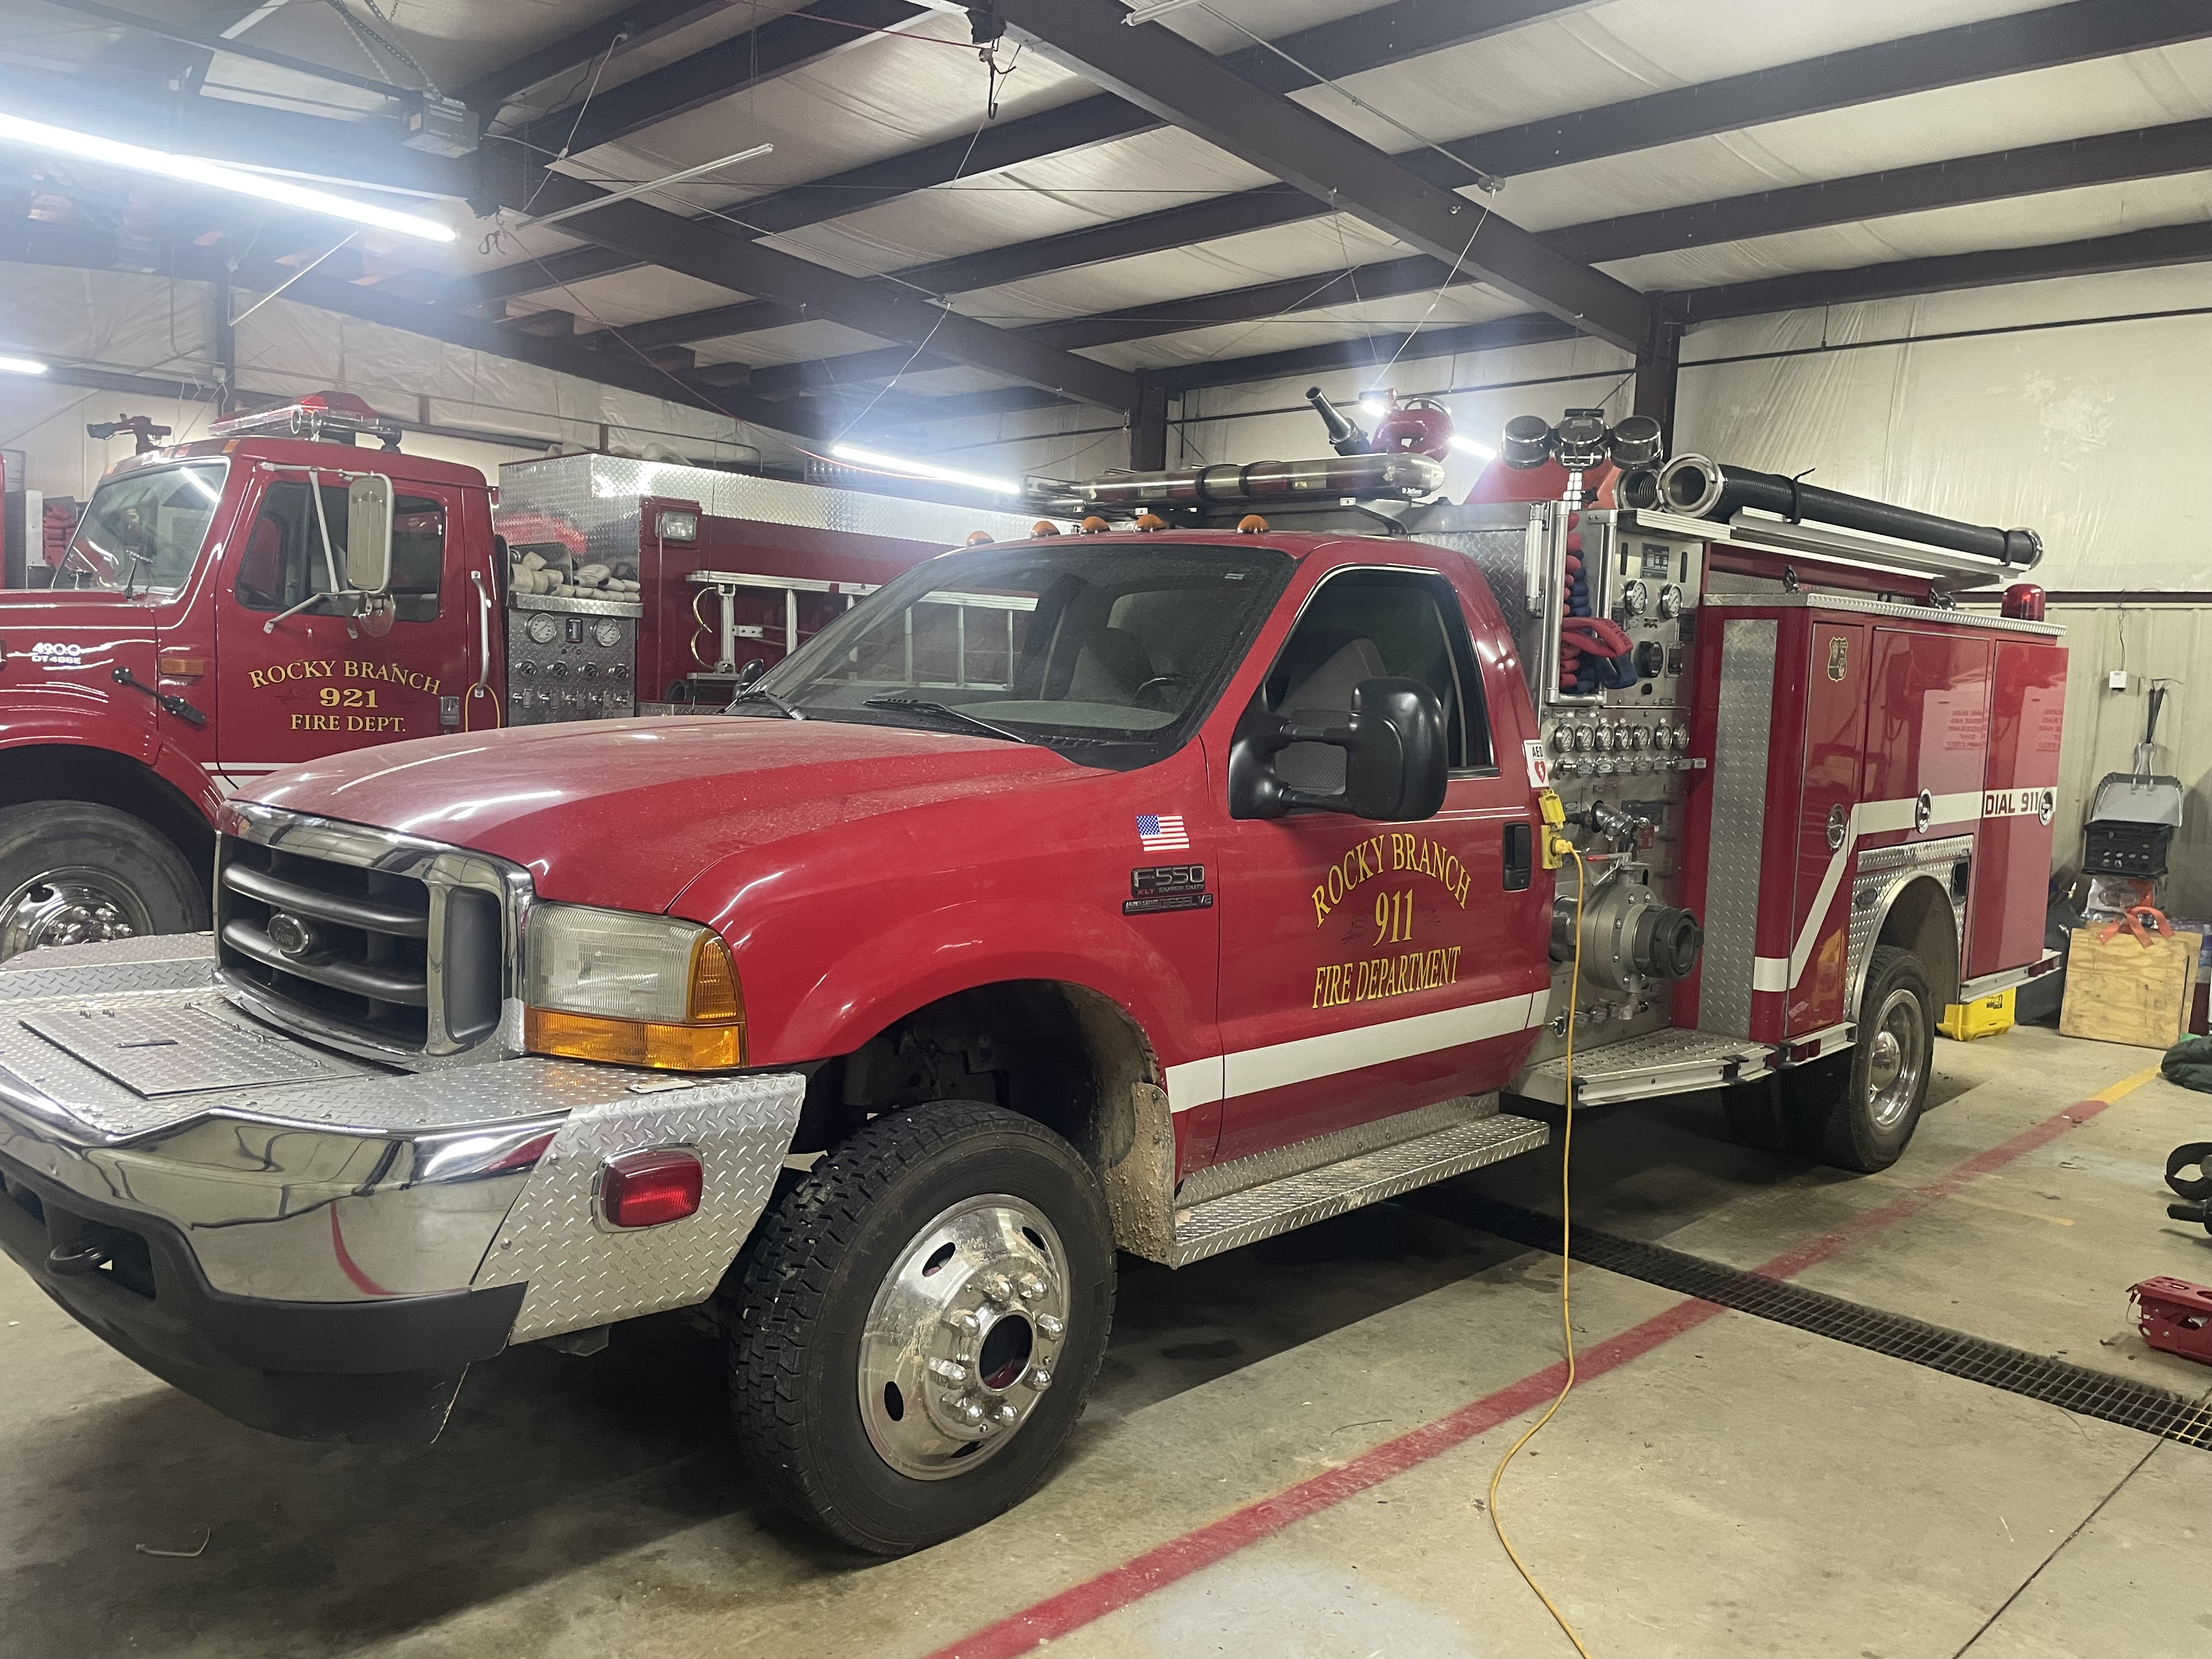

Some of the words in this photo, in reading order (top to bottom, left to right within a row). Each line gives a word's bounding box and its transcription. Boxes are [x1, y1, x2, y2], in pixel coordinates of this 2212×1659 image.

[32, 642, 81, 656] 4900
[248, 660, 336, 689] ROCKY
[343, 661, 441, 695] BRANCH
[320, 687, 379, 708] 921
[290, 714, 340, 731] FIRE
[346, 715, 406, 732] DEPT.
[1532, 746, 1543, 757] AED
[1985, 793, 2015, 815] DIAL
[2021, 792, 2039, 812] 911
[1133, 866, 1205, 888] F-550
[1312, 834, 1384, 928] ROCKY
[1391, 833, 1471, 910] BRANCH
[1373, 888, 1413, 947] 911
[274, 922, 295, 946] Ford
[1312, 963, 1353, 1009] FIRE
[1355, 946, 1461, 1001] DEPARTMENT
